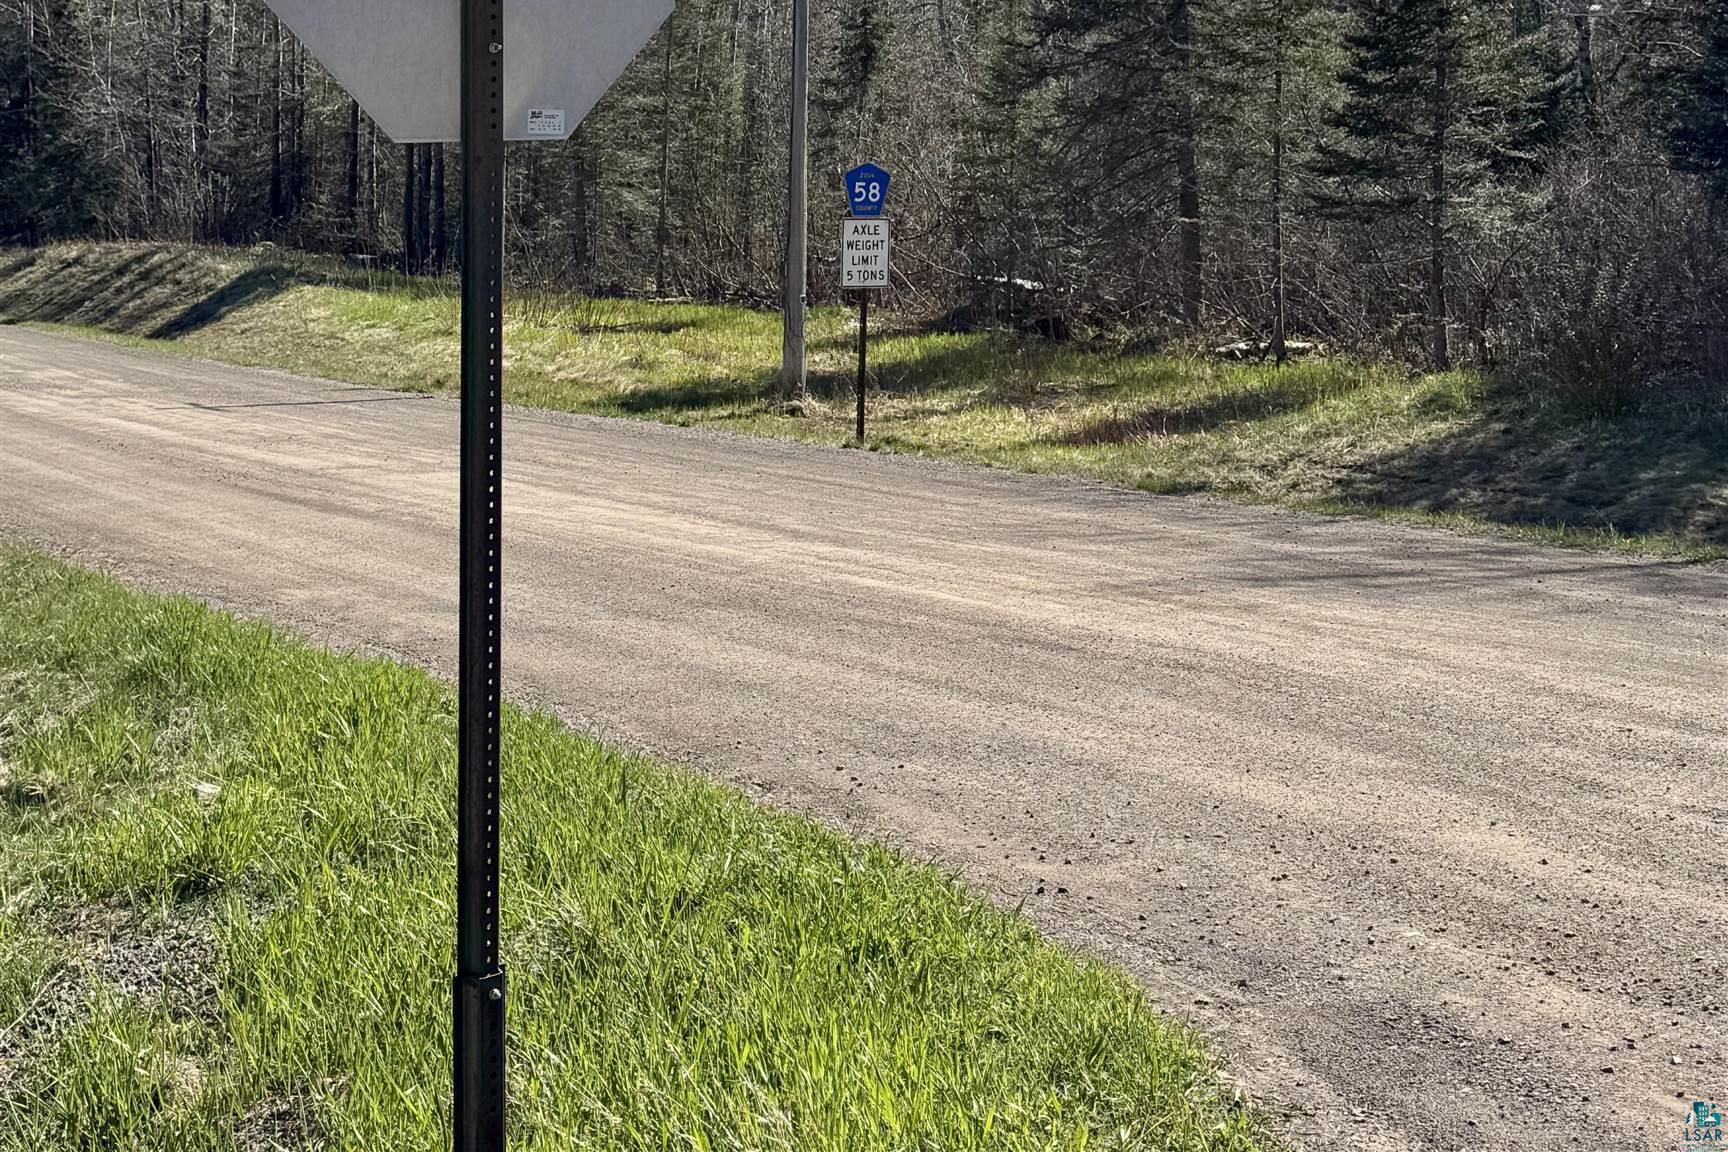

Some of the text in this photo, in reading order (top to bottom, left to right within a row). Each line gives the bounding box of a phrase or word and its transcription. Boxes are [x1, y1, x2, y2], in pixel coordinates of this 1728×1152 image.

[854, 182, 880, 202] 58
[852, 225, 880, 235] AXLE
[846, 240, 885, 250] WEIGHT
[851, 255, 879, 266] LIMIT
[847, 270, 885, 281] 5 TONS
